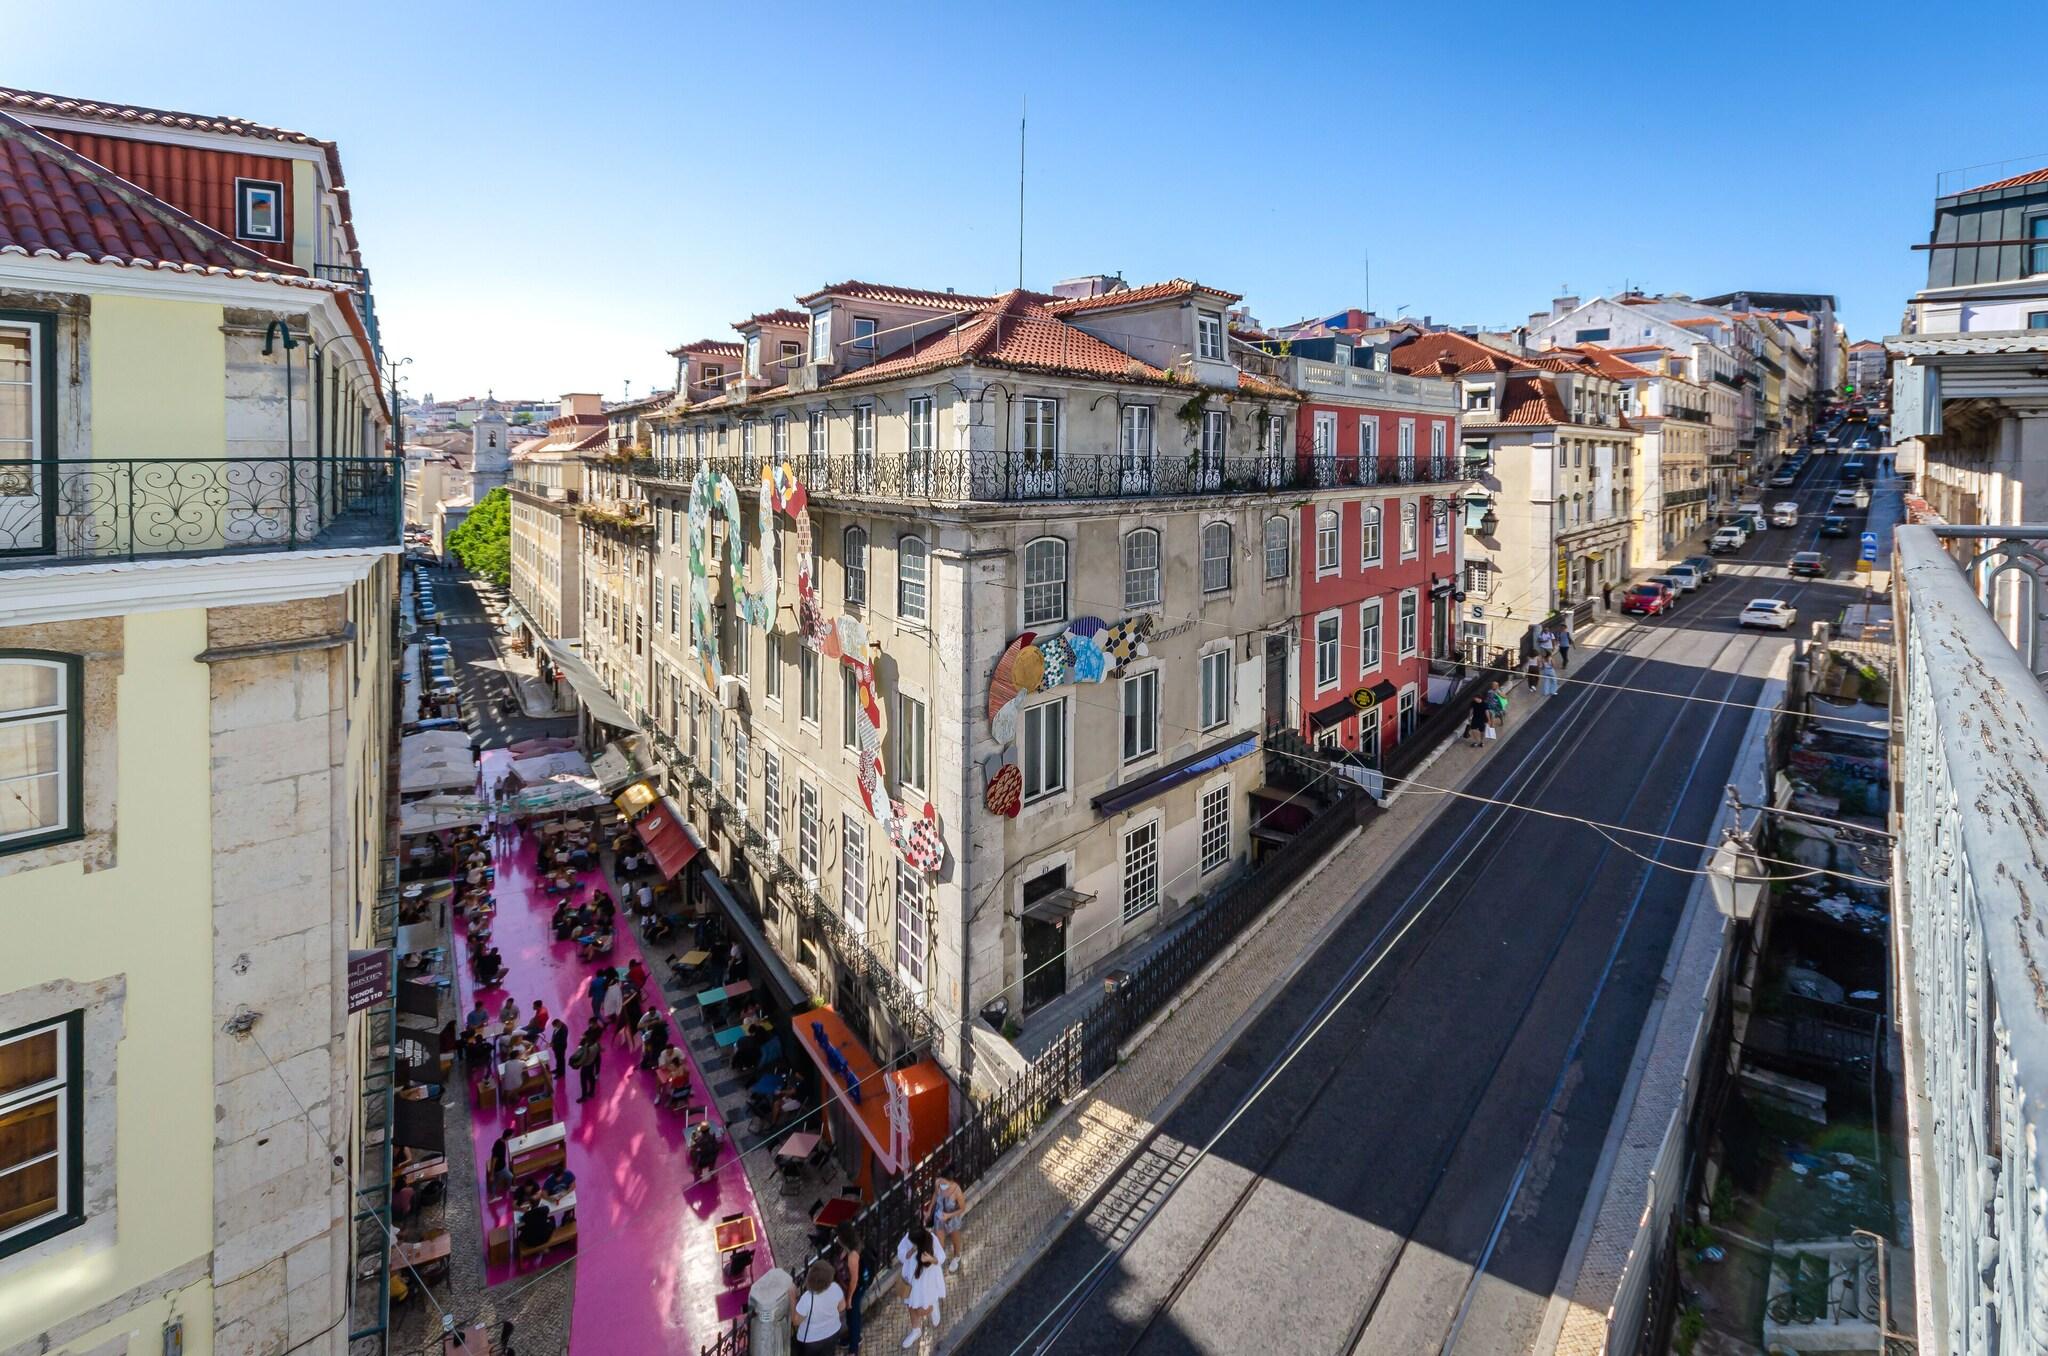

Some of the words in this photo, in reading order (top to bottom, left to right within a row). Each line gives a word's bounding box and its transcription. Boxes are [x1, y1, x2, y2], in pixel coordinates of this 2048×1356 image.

[1757, 521, 1765, 529] S
[1473, 607, 1482, 618] S
[350, 987, 374, 1001] VENDE
[370, 991, 383, 1001] 110
